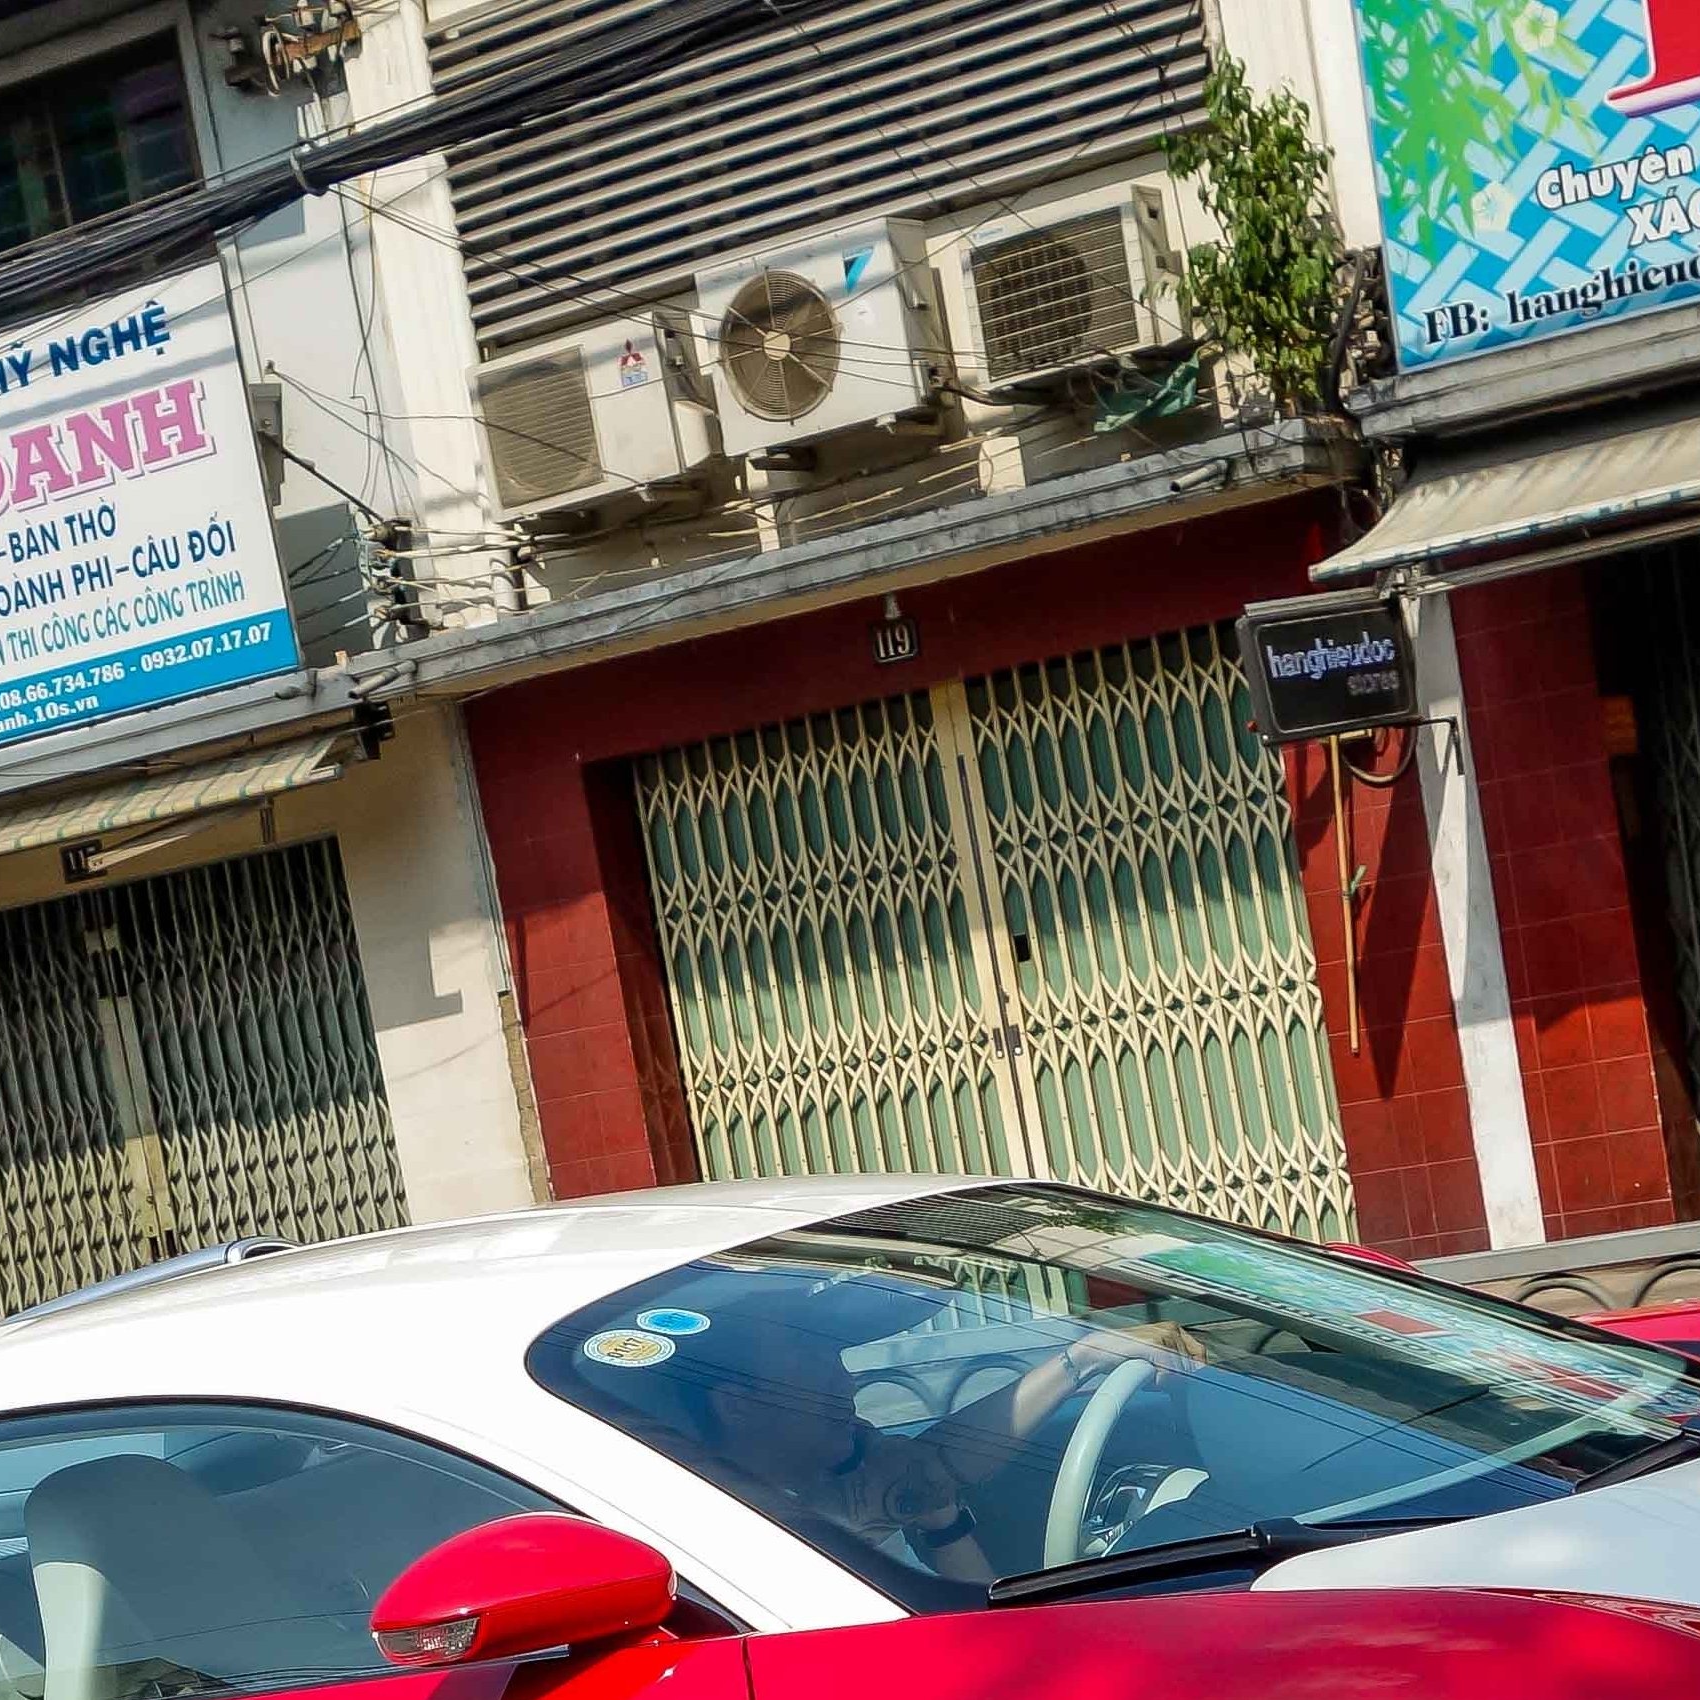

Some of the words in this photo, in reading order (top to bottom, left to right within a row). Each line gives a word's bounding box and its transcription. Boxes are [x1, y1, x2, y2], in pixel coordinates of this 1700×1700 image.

[1535, 146, 1694, 210] Chuyên
[48, 300, 171, 378] NGHỆ
[1422, 301, 1491, 346] FB:
[64, 495, 118, 547] THỜ
[187, 510, 237, 564] ĐỐI
[7, 625, 38, 663] THI
[41, 612, 90, 653] CÔNG
[93, 598, 131, 639] CÁC
[133, 586, 184, 628] CÔNG
[185, 568, 245, 614] TRÌNH
[876, 624, 910, 658] 119
[141, 622, 273, 673] 0932.07.17.07
